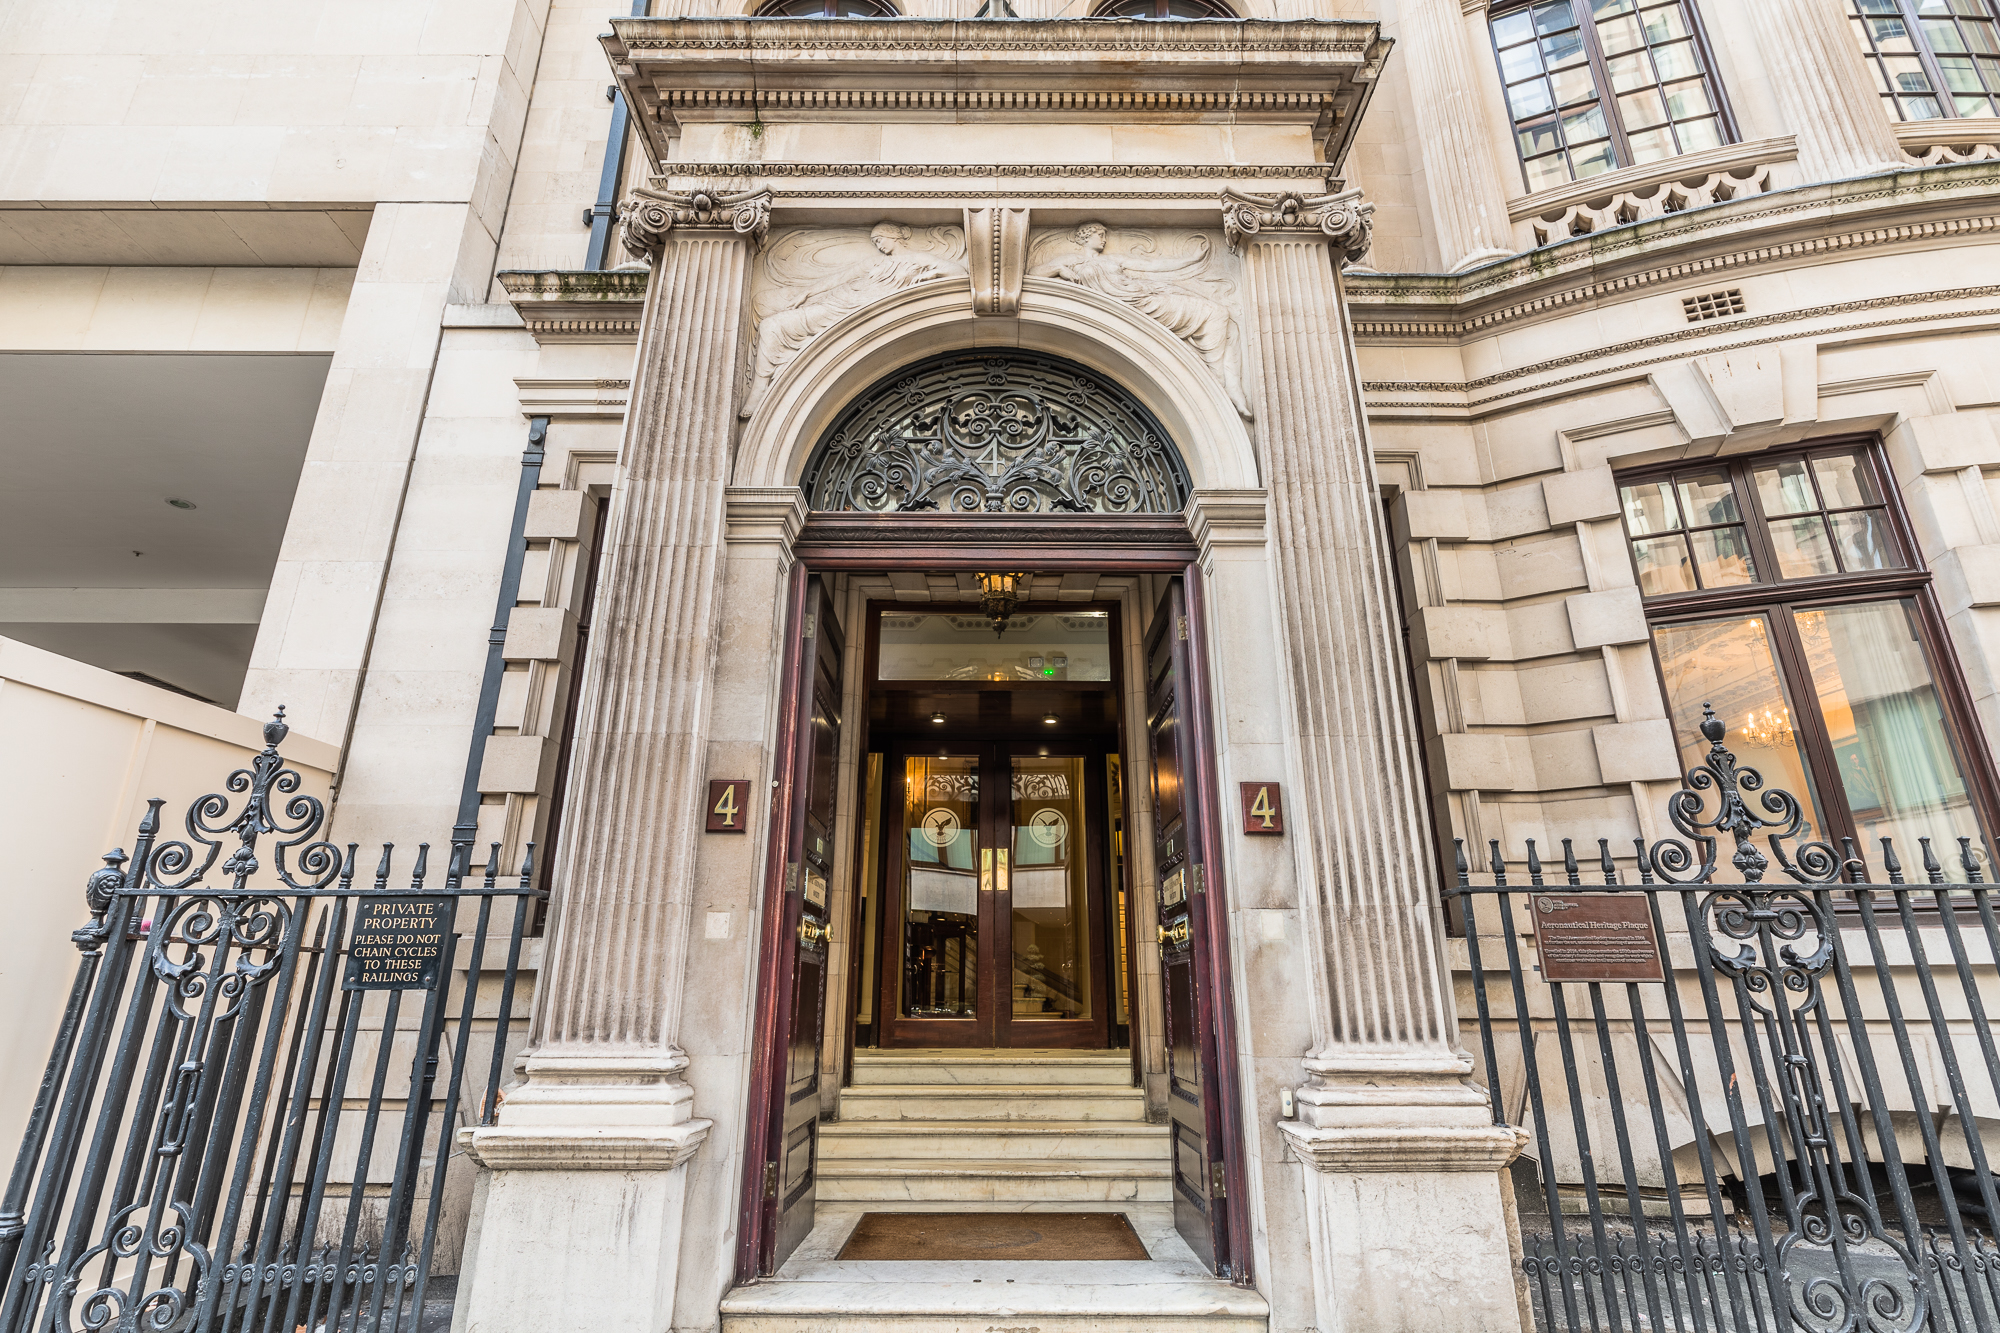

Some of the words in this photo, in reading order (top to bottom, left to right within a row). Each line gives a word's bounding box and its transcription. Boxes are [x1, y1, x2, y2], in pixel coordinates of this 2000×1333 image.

[975, 437, 1006, 477] 4
[714, 784, 739, 826] 4
[1251, 786, 1276, 828] 4
[373, 903, 434, 915] PRIVATE
[363, 917, 438, 929] PROPERTY
[1541, 921, 1589, 929] Aeronautical
[1589, 921, 1622, 931] Heritage
[1622, 921, 1649, 931] Plaque
[354, 934, 394, 945] PLEASE
[396, 934, 414, 944] DO
[415, 934, 441, 944] NOT
[354, 947, 391, 957] CHAIN
[394, 947, 437, 957] CYCLES
[364, 959, 381, 970] TO
[384, 959, 422, 969] THESE
[361, 972, 419, 982] RAILINGS
